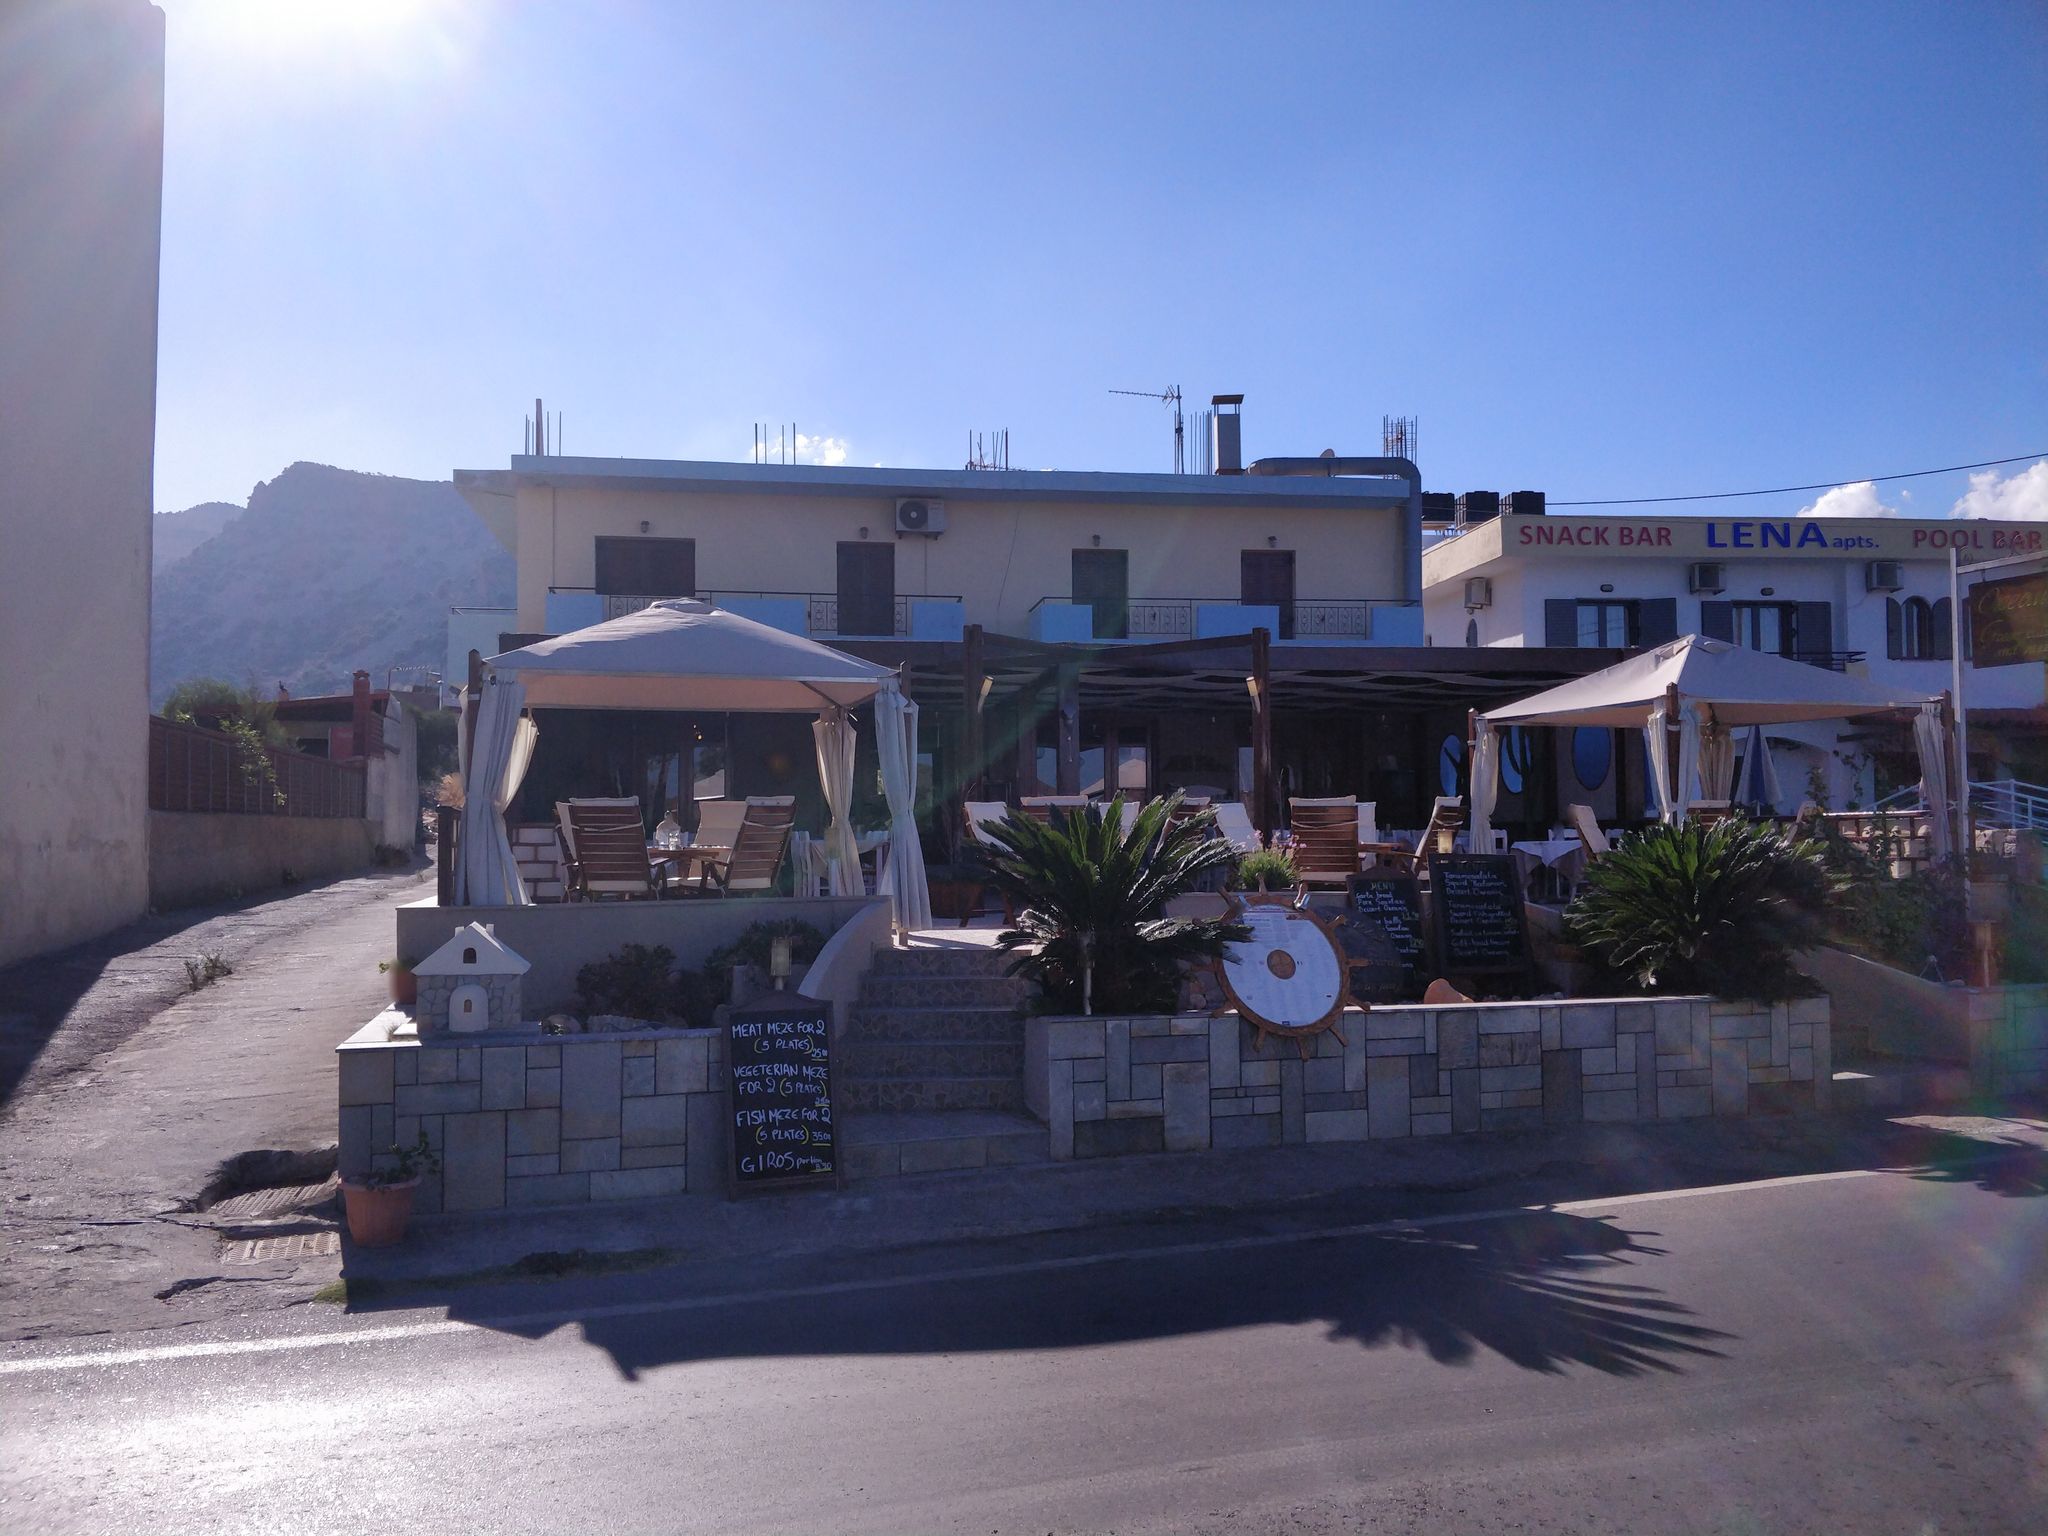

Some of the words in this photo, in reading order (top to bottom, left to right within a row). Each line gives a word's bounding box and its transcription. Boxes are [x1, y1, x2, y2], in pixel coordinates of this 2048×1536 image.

[1519, 525, 1610, 546] SNACK
[1619, 526, 1673, 547] BAR
[1706, 521, 1829, 549] LENA
[1832, 534, 1880, 552] apts.
[1912, 529, 1984, 550] POOL
[1992, 530, 2043, 551] BAR
[732, 1023, 762, 1039] MEAT
[767, 1022, 794, 1037] MEZE
[798, 1022, 815, 1034] FOR
[815, 1020, 826, 1036] 2
[802, 1065, 829, 1082] MEZE
[739, 1081, 763, 1096] FOR
[765, 1077, 776, 1093] 2
[736, 1110, 766, 1127] FISH
[768, 1108, 799, 1127] MEZE
[801, 1108, 819, 1122] FOR
[821, 1107, 832, 1125] 2
[741, 1151, 795, 1174] GIROS
